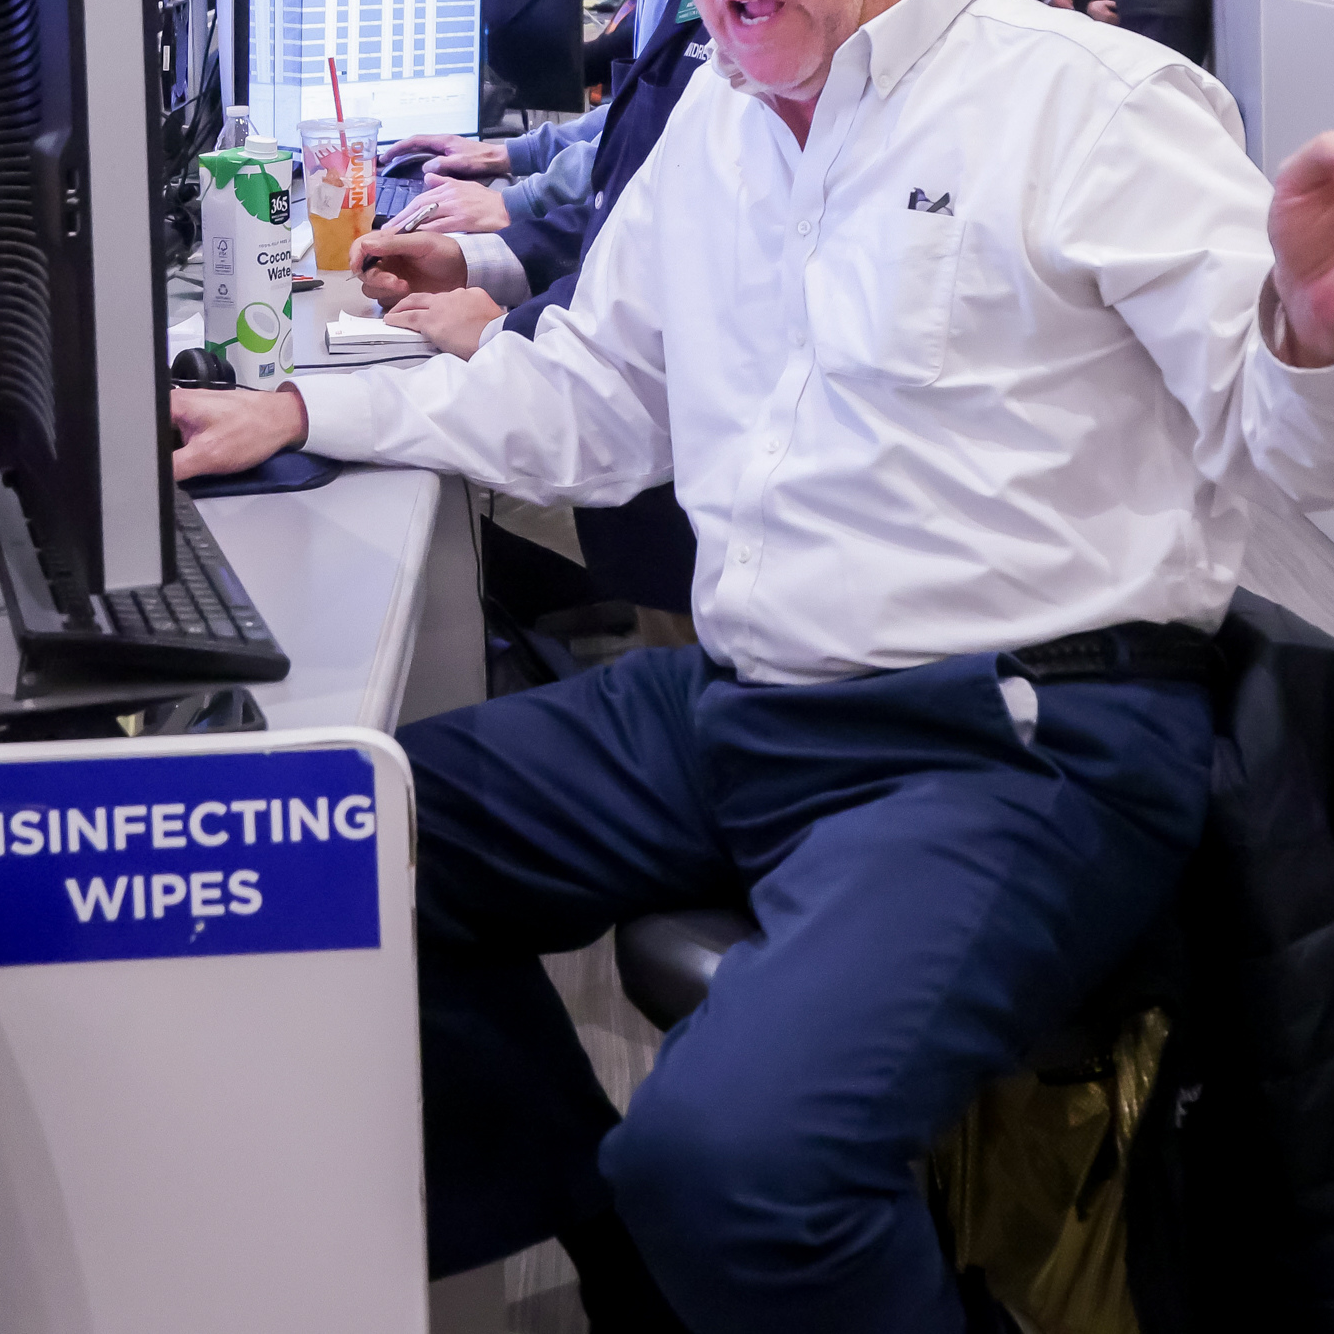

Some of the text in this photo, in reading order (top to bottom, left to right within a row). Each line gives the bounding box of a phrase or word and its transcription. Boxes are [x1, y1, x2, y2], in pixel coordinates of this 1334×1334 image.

[270, 195, 288, 215] 365
[257, 250, 292, 266] Cocon
[267, 266, 291, 282] Wate
[64, 869, 264, 925] WIPES
